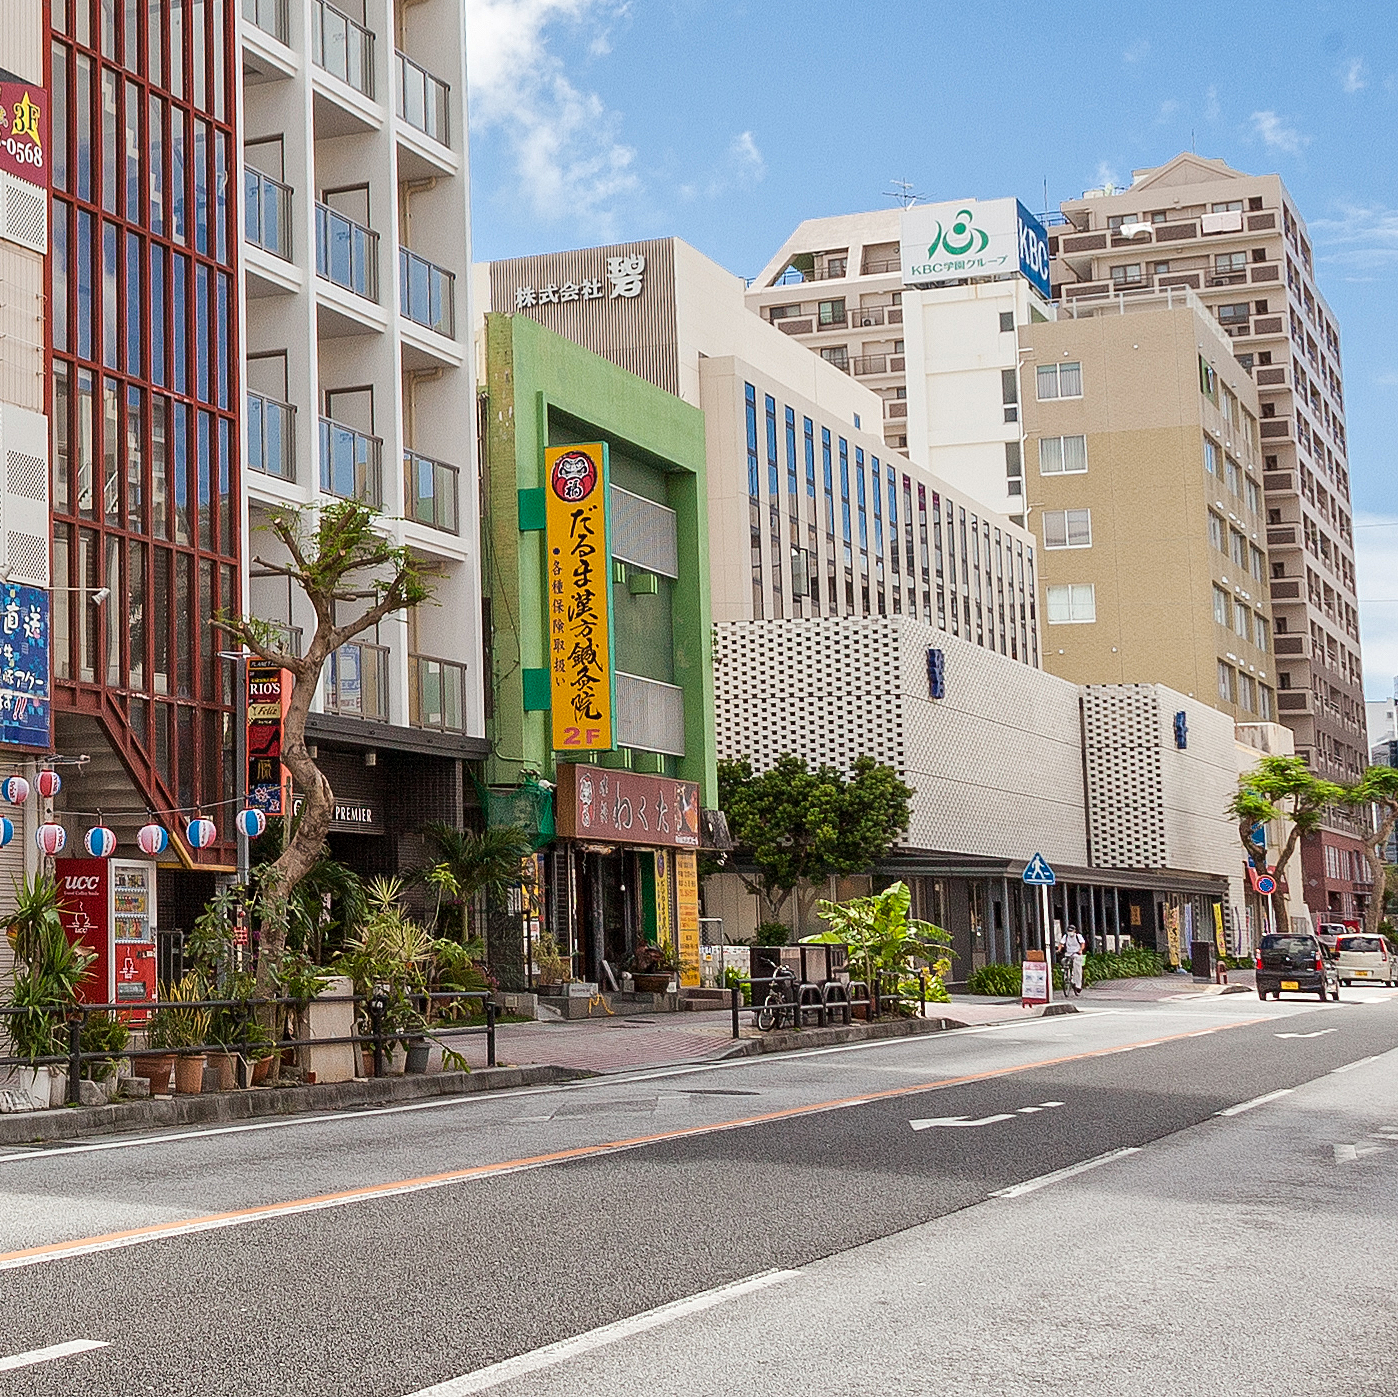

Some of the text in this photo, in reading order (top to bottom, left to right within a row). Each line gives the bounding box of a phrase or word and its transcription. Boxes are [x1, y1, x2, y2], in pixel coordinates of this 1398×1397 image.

[14, 103, 40, 132] 3F
[1018, 216, 1048, 281] KBC
[911, 255, 1008, 276] KBC学園グループ
[516, 277, 604, 309] 株式会社
[250, 683, 281, 695] RIO'S
[563, 725, 600, 746] 2F
[335, 805, 372, 823] PREMIER
